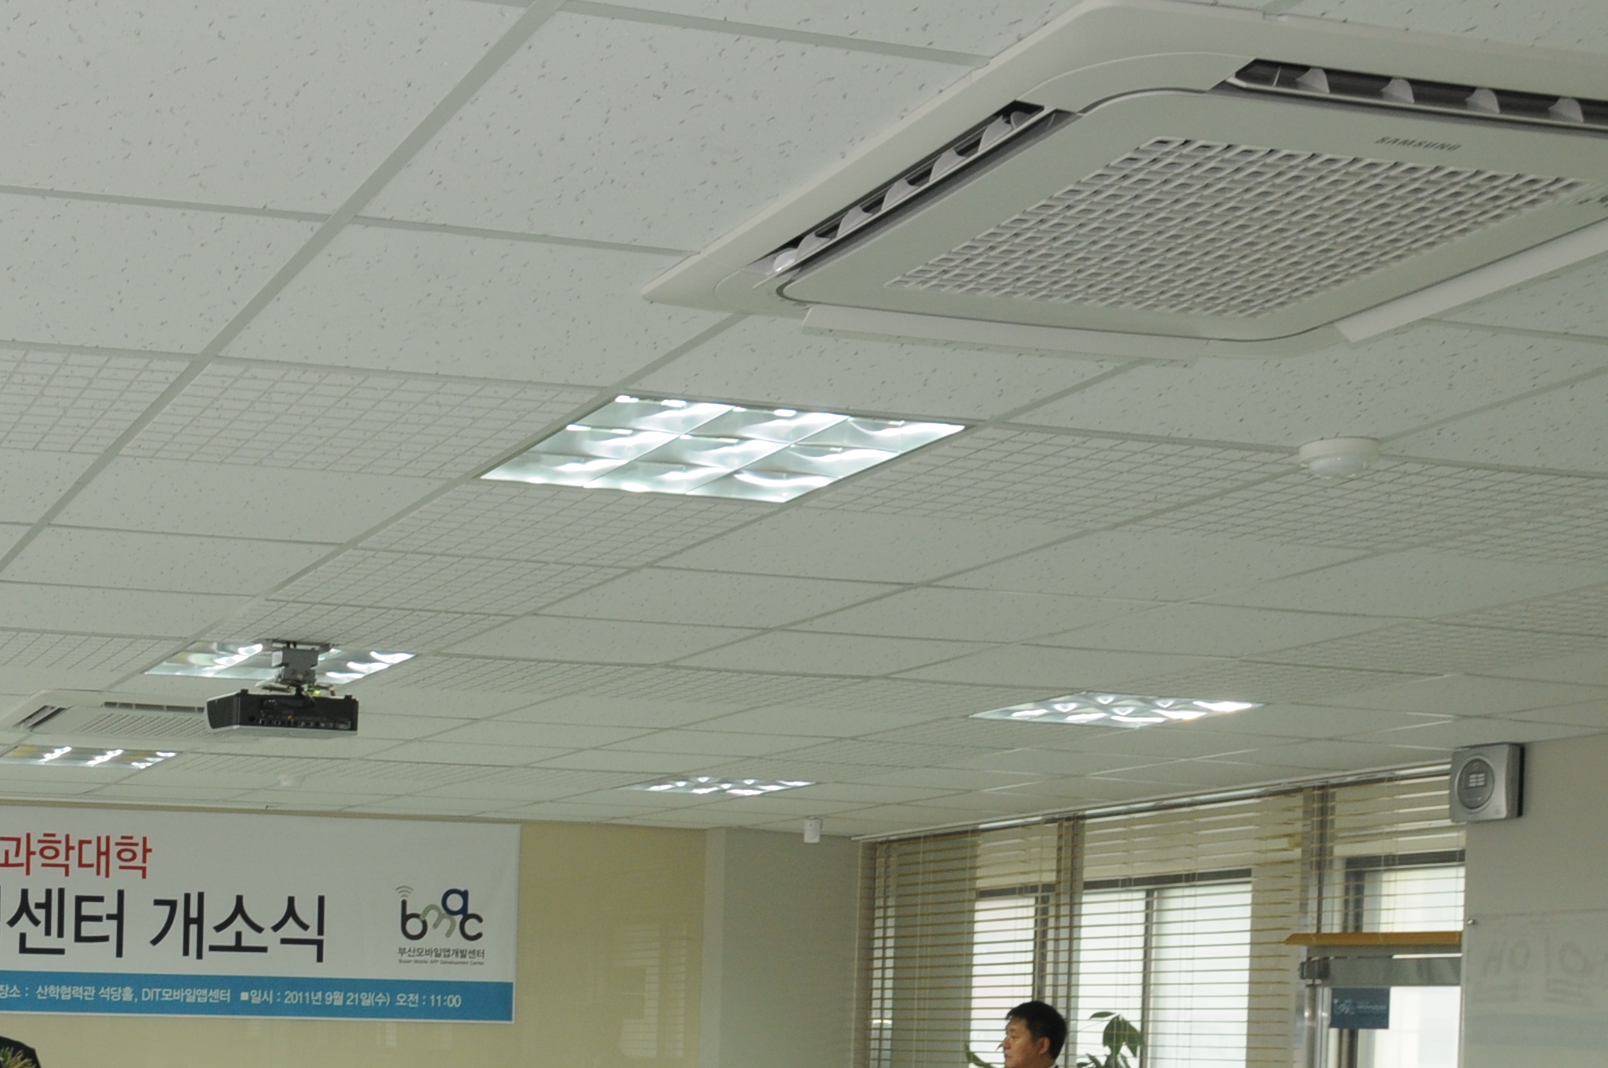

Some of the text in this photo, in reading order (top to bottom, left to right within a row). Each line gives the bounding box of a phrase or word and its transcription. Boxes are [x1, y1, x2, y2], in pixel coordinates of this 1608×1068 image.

[1374, 136, 1461, 152] SAMSUNG
[149, 891, 327, 963] 개소식
[36, 985, 95, 1000] 산학협력관
[250, 989, 273, 1004] 일시
[284, 990, 322, 1005] 2011년
[325, 990, 343, 1006] 9월
[346, 991, 390, 1007] 21일(수)
[395, 992, 419, 1008] 오전
[430, 994, 462, 1008] 11:00
